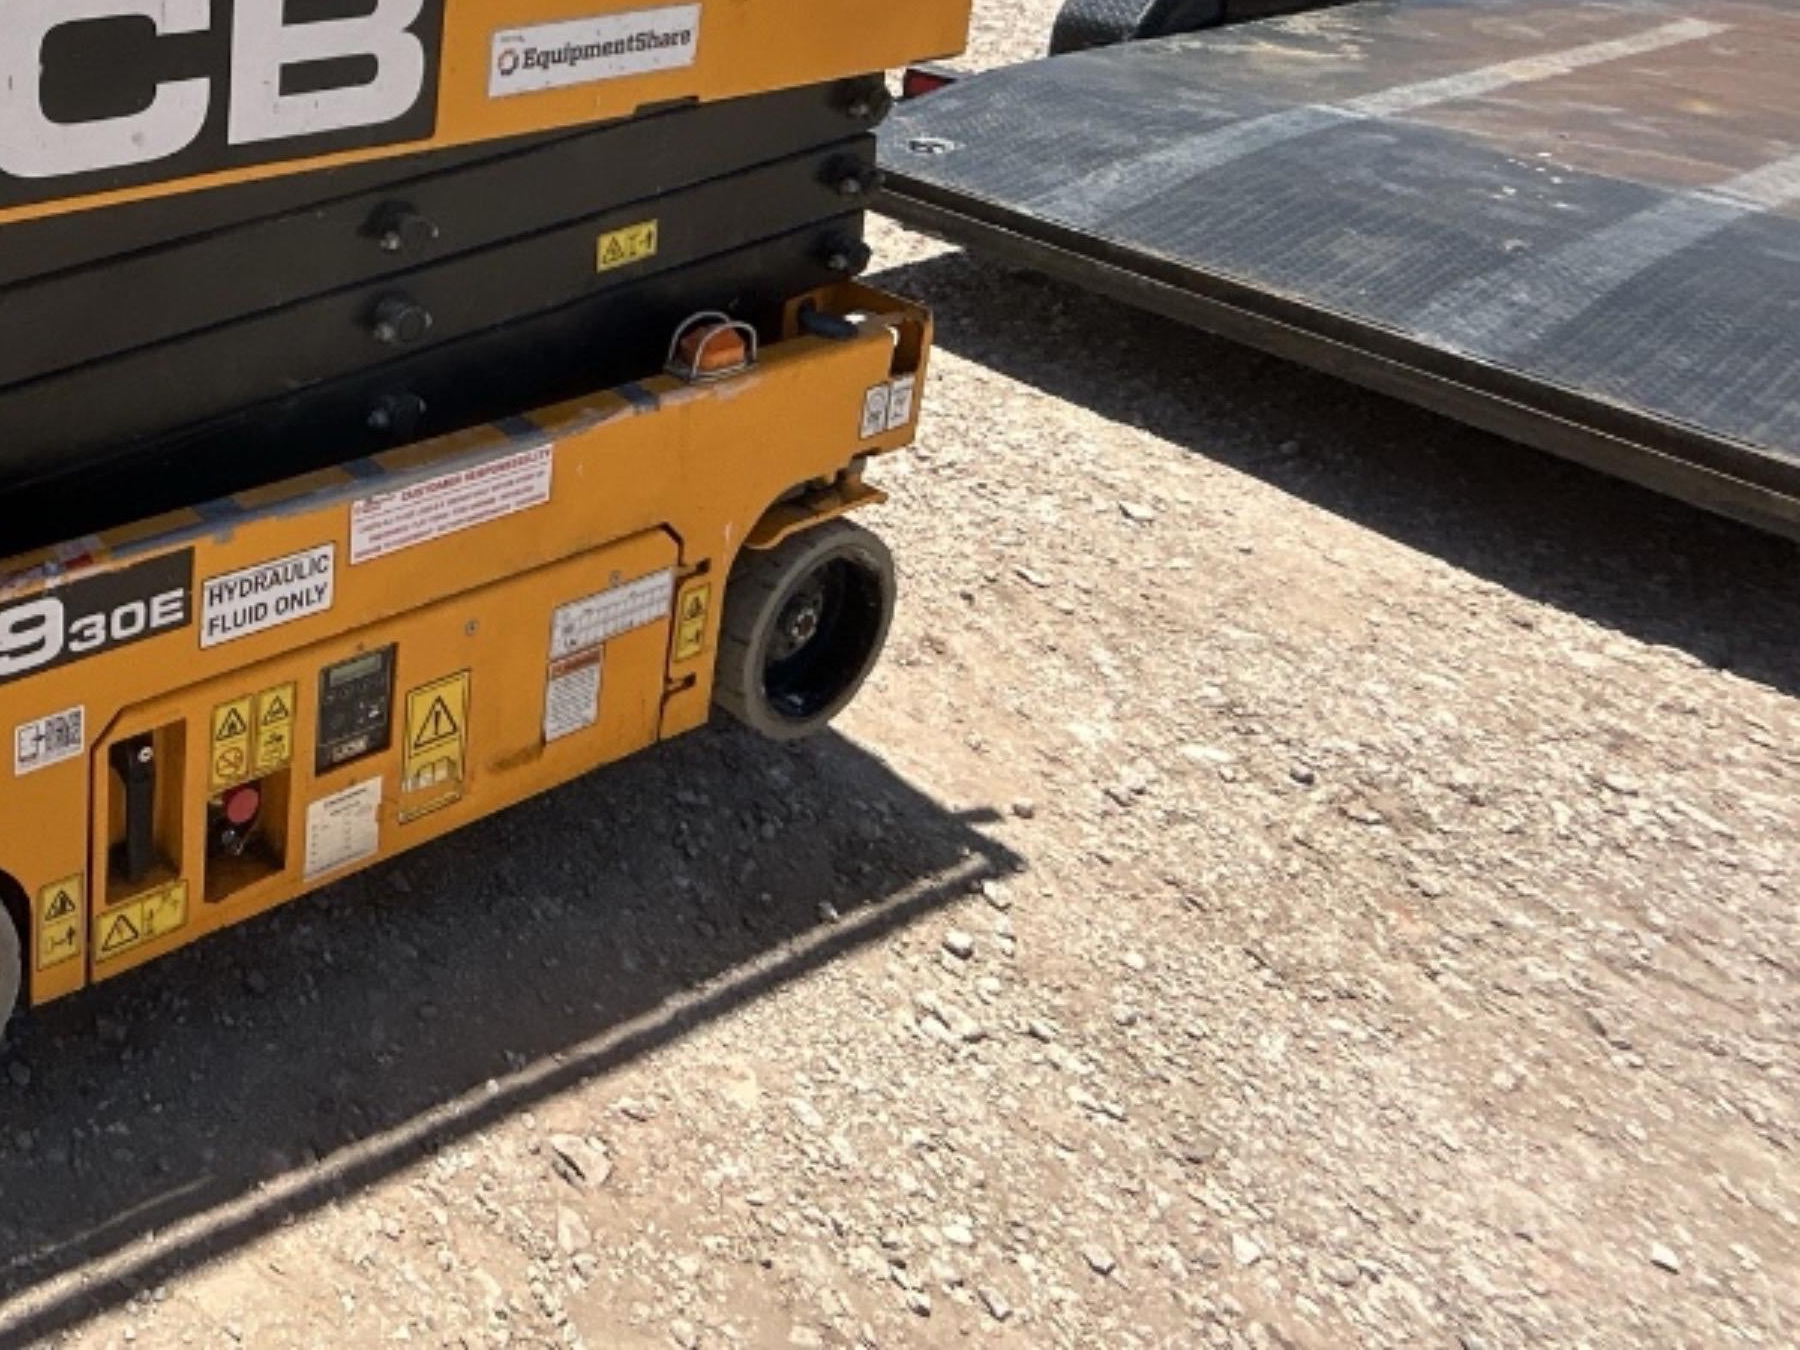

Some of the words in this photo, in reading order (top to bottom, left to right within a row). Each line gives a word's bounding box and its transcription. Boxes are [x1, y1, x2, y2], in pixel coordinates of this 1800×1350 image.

[521, 28, 692, 70] EquipmentShare
[209, 554, 329, 607] HYDRAULIC
[208, 602, 268, 637] FLUID
[275, 582, 328, 616] ONLY
